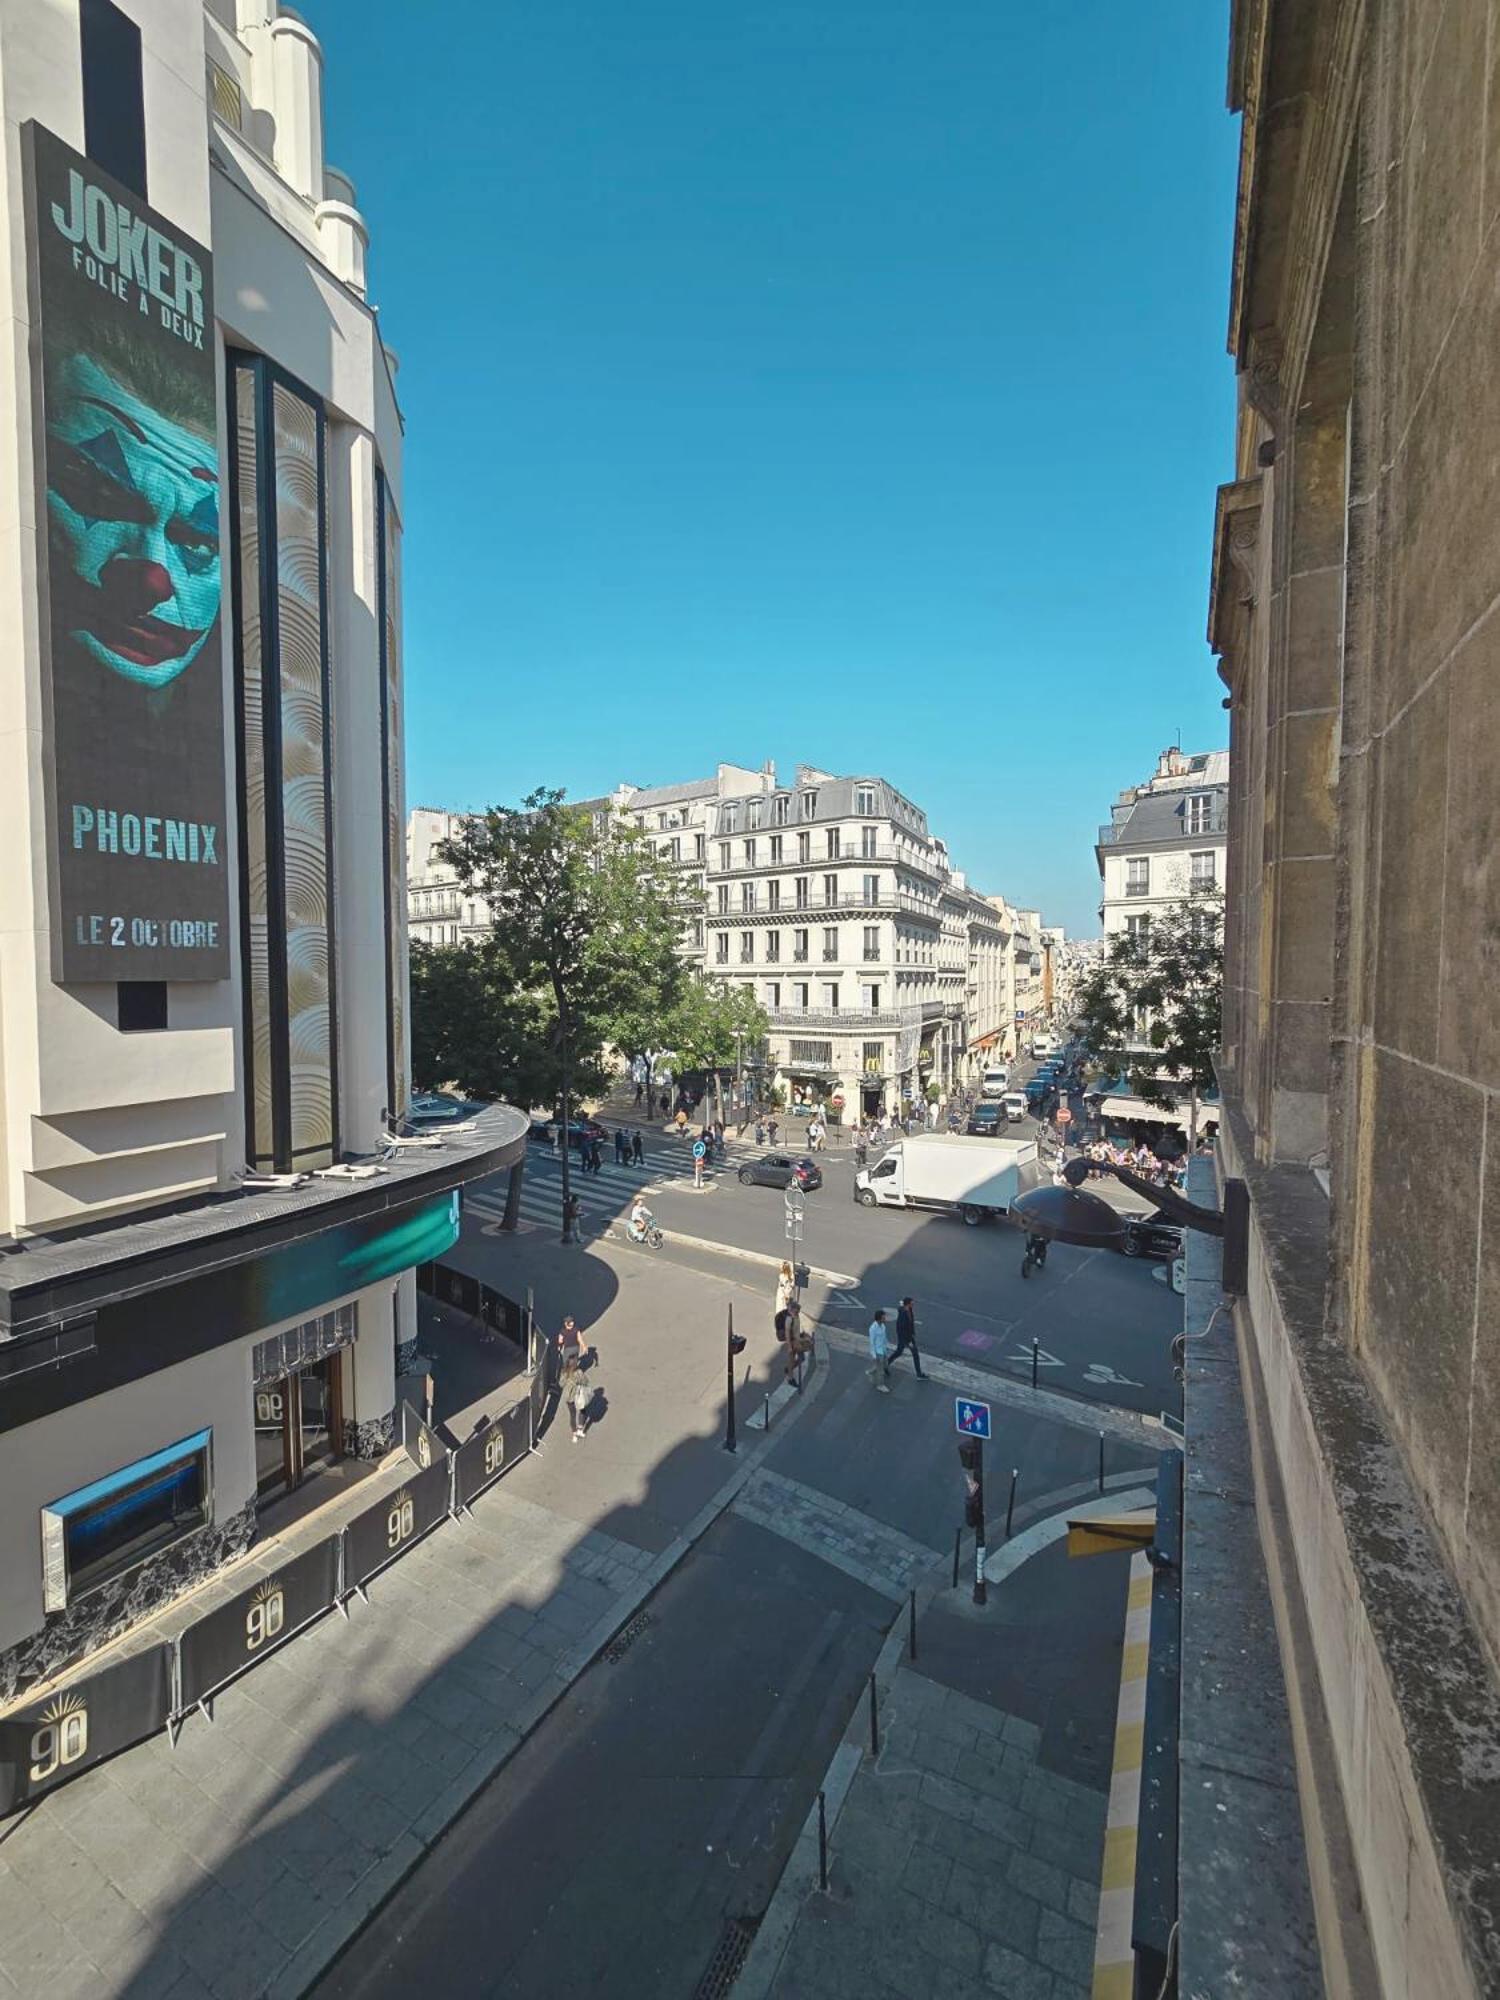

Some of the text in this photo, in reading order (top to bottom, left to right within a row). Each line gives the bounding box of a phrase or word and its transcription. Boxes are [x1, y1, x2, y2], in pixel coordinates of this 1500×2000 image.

[51, 168, 204, 328] JOKER
[72, 246, 129, 303] FOLIE
[161, 308, 203, 350] DEUX
[72, 804, 218, 865] PHOENIX
[76, 915, 219, 948] LE 2 OCTOBRE
[486, 1433, 504, 1474] 90
[387, 1499, 414, 1548] 90
[246, 1591, 284, 1650] 90
[30, 1708, 88, 1782] 90
